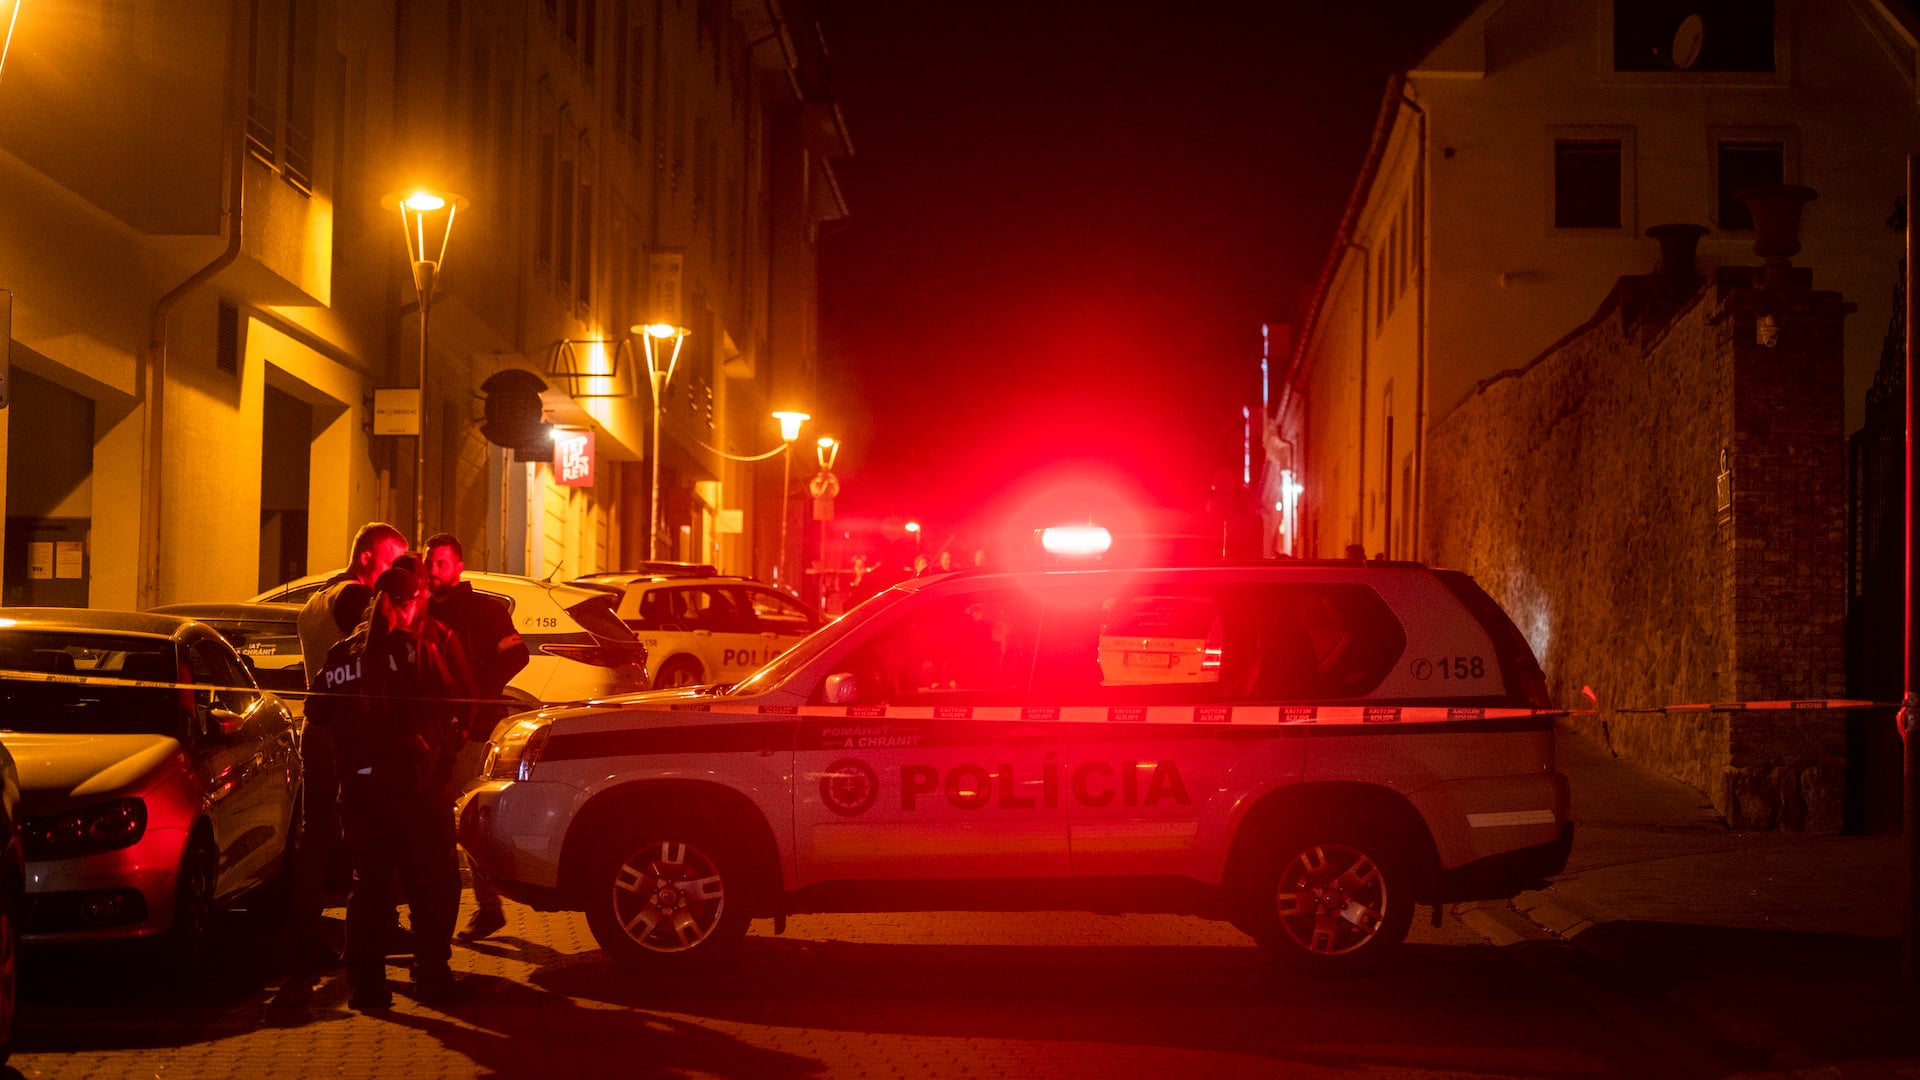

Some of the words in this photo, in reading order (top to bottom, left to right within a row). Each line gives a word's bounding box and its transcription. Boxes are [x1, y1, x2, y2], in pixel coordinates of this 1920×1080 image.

[536, 618, 557, 627] 158
[1437, 656, 1485, 680] 158
[844, 738, 853, 747] A
[900, 752, 1192, 811] POLÍCIA
